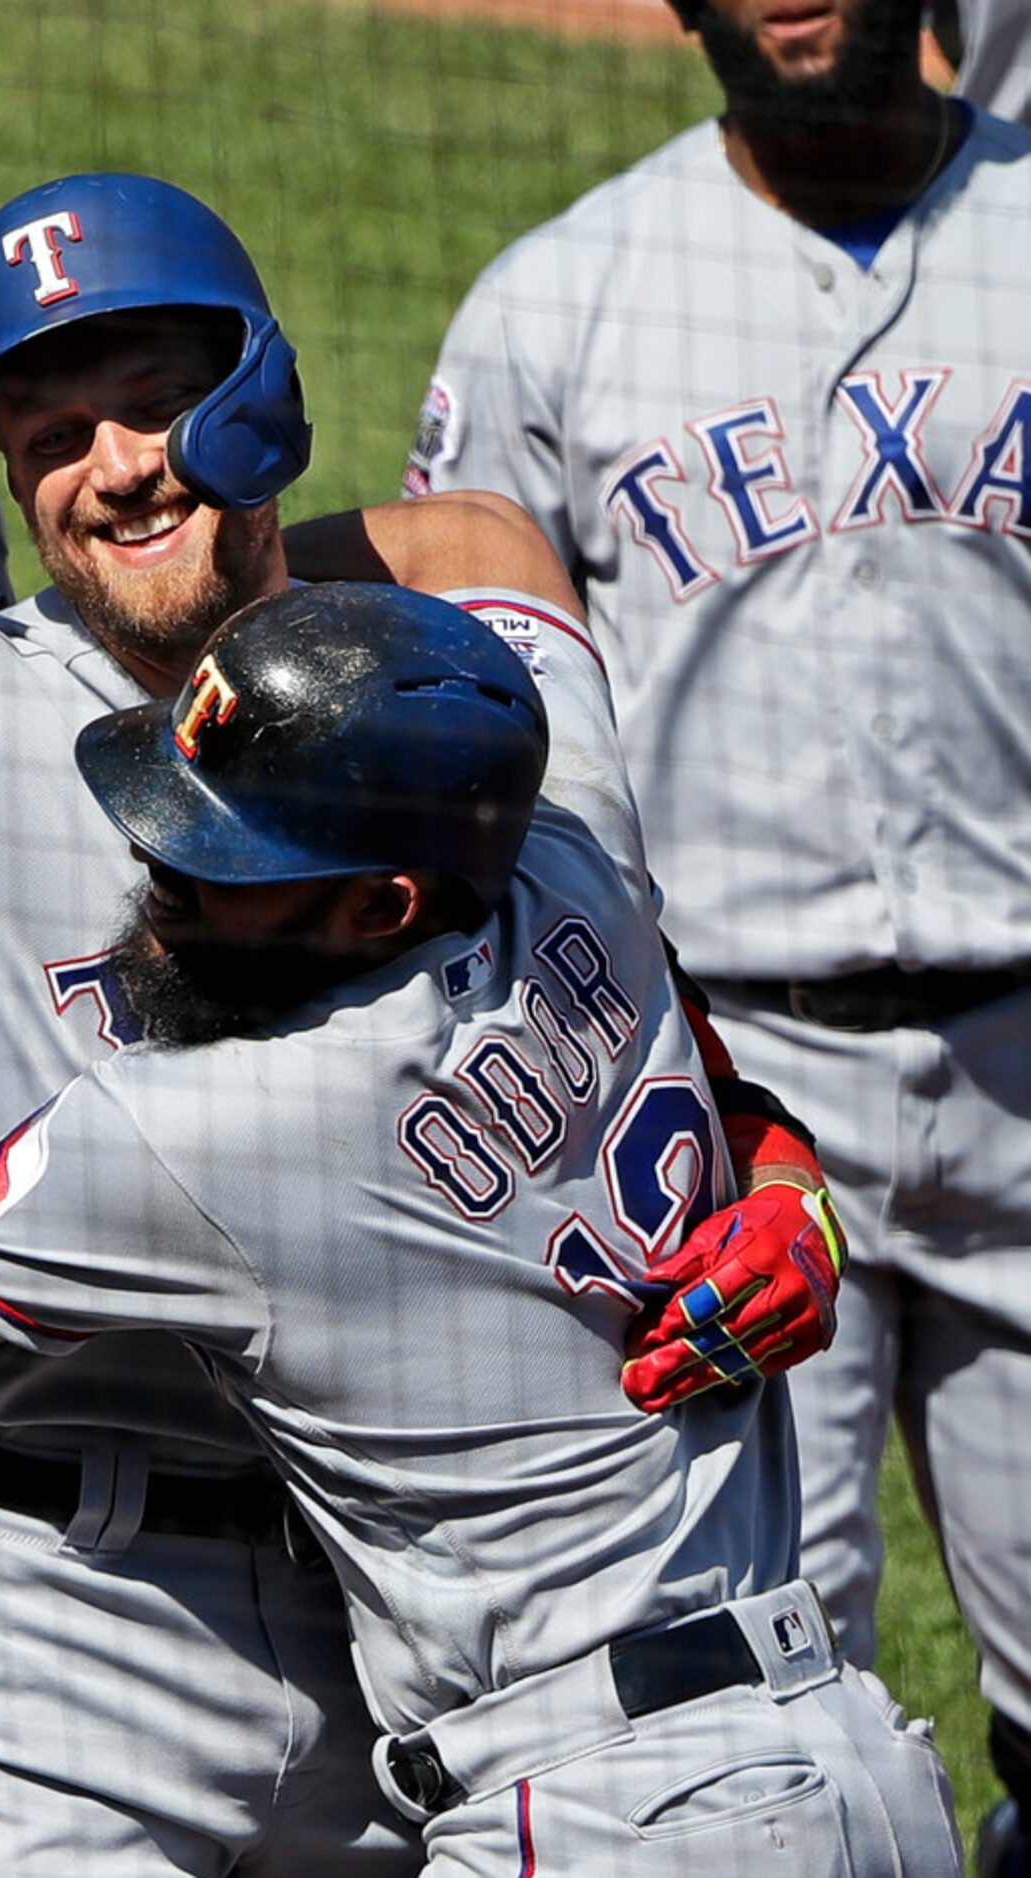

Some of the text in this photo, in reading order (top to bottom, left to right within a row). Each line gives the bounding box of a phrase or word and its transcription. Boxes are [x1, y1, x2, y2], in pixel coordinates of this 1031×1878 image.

[2, 210, 82, 307] T
[174, 653, 238, 760] T
[398, 915, 641, 1223] ODOR
